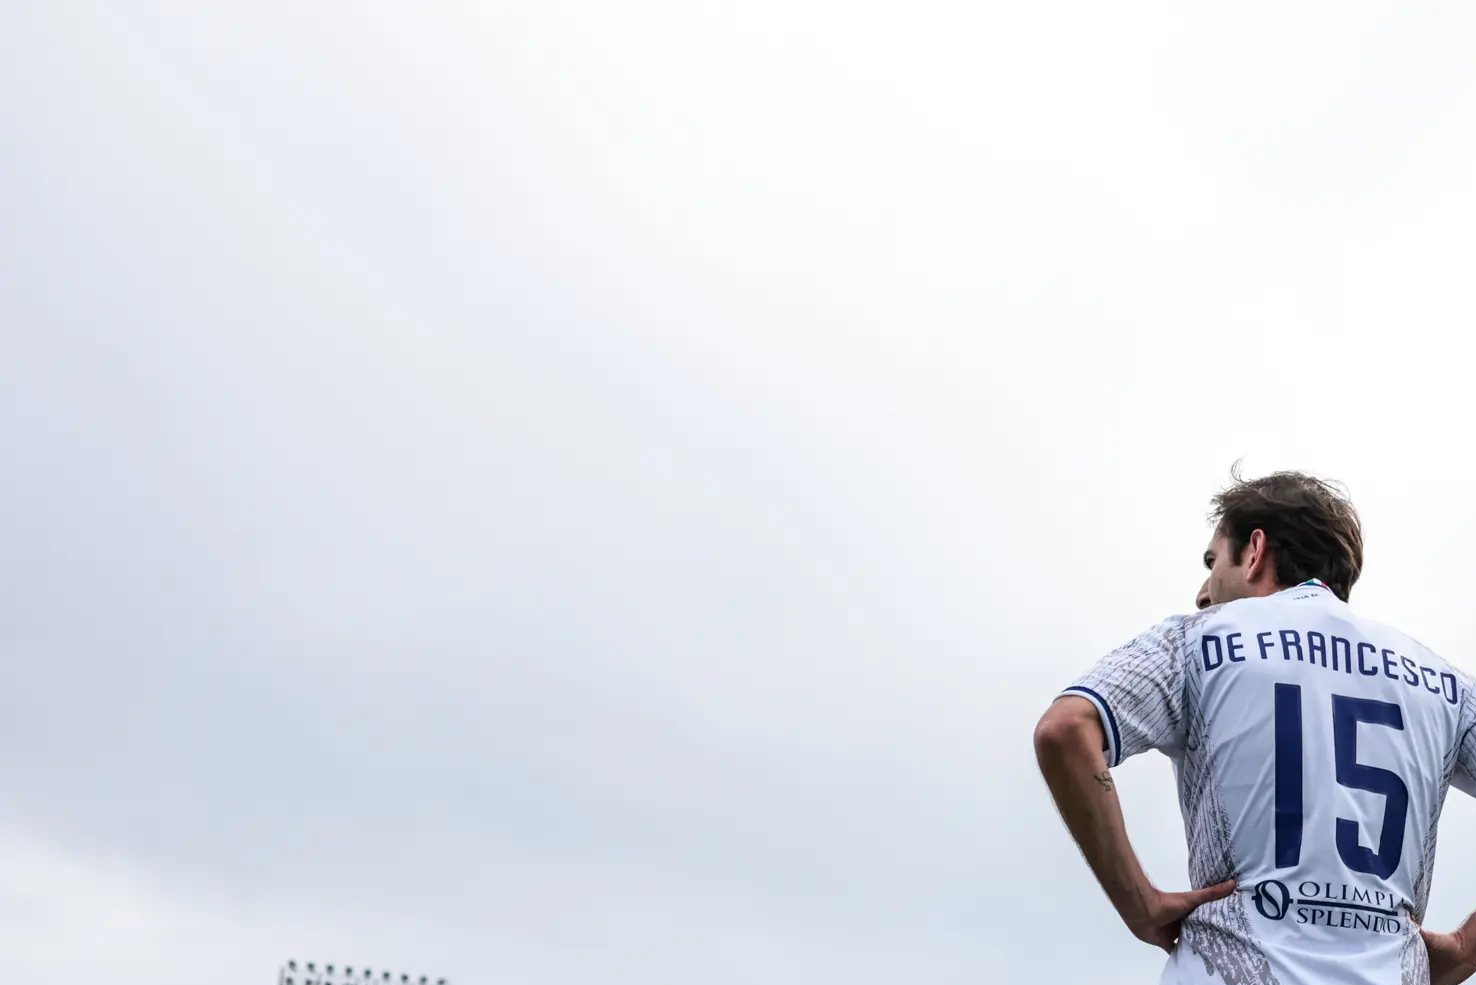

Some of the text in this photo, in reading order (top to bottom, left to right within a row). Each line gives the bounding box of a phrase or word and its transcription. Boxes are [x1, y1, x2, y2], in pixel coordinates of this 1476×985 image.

[1201, 629, 1458, 705] DE FRANCESCO
[1273, 682, 1410, 881] 15
